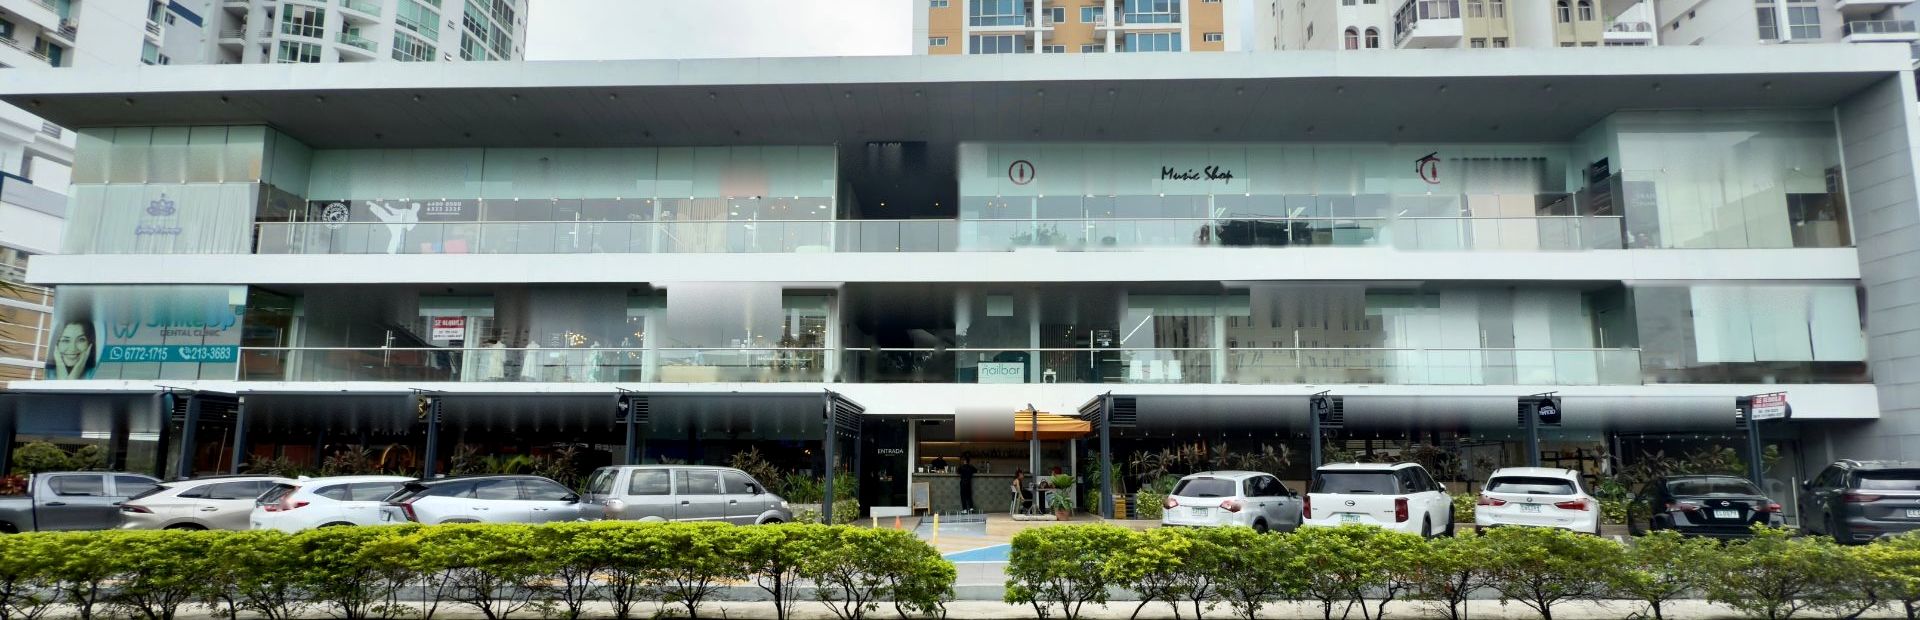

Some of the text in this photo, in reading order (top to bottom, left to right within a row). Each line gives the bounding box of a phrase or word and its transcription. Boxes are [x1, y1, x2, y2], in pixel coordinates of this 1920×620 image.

[1161, 165, 1234, 185] Music Shop
[160, 329, 221, 337] DENTAL CLINIC
[124, 347, 168, 360] 6772-1715
[191, 347, 231, 360] 213-3683
[981, 363, 1021, 376] nailbar
